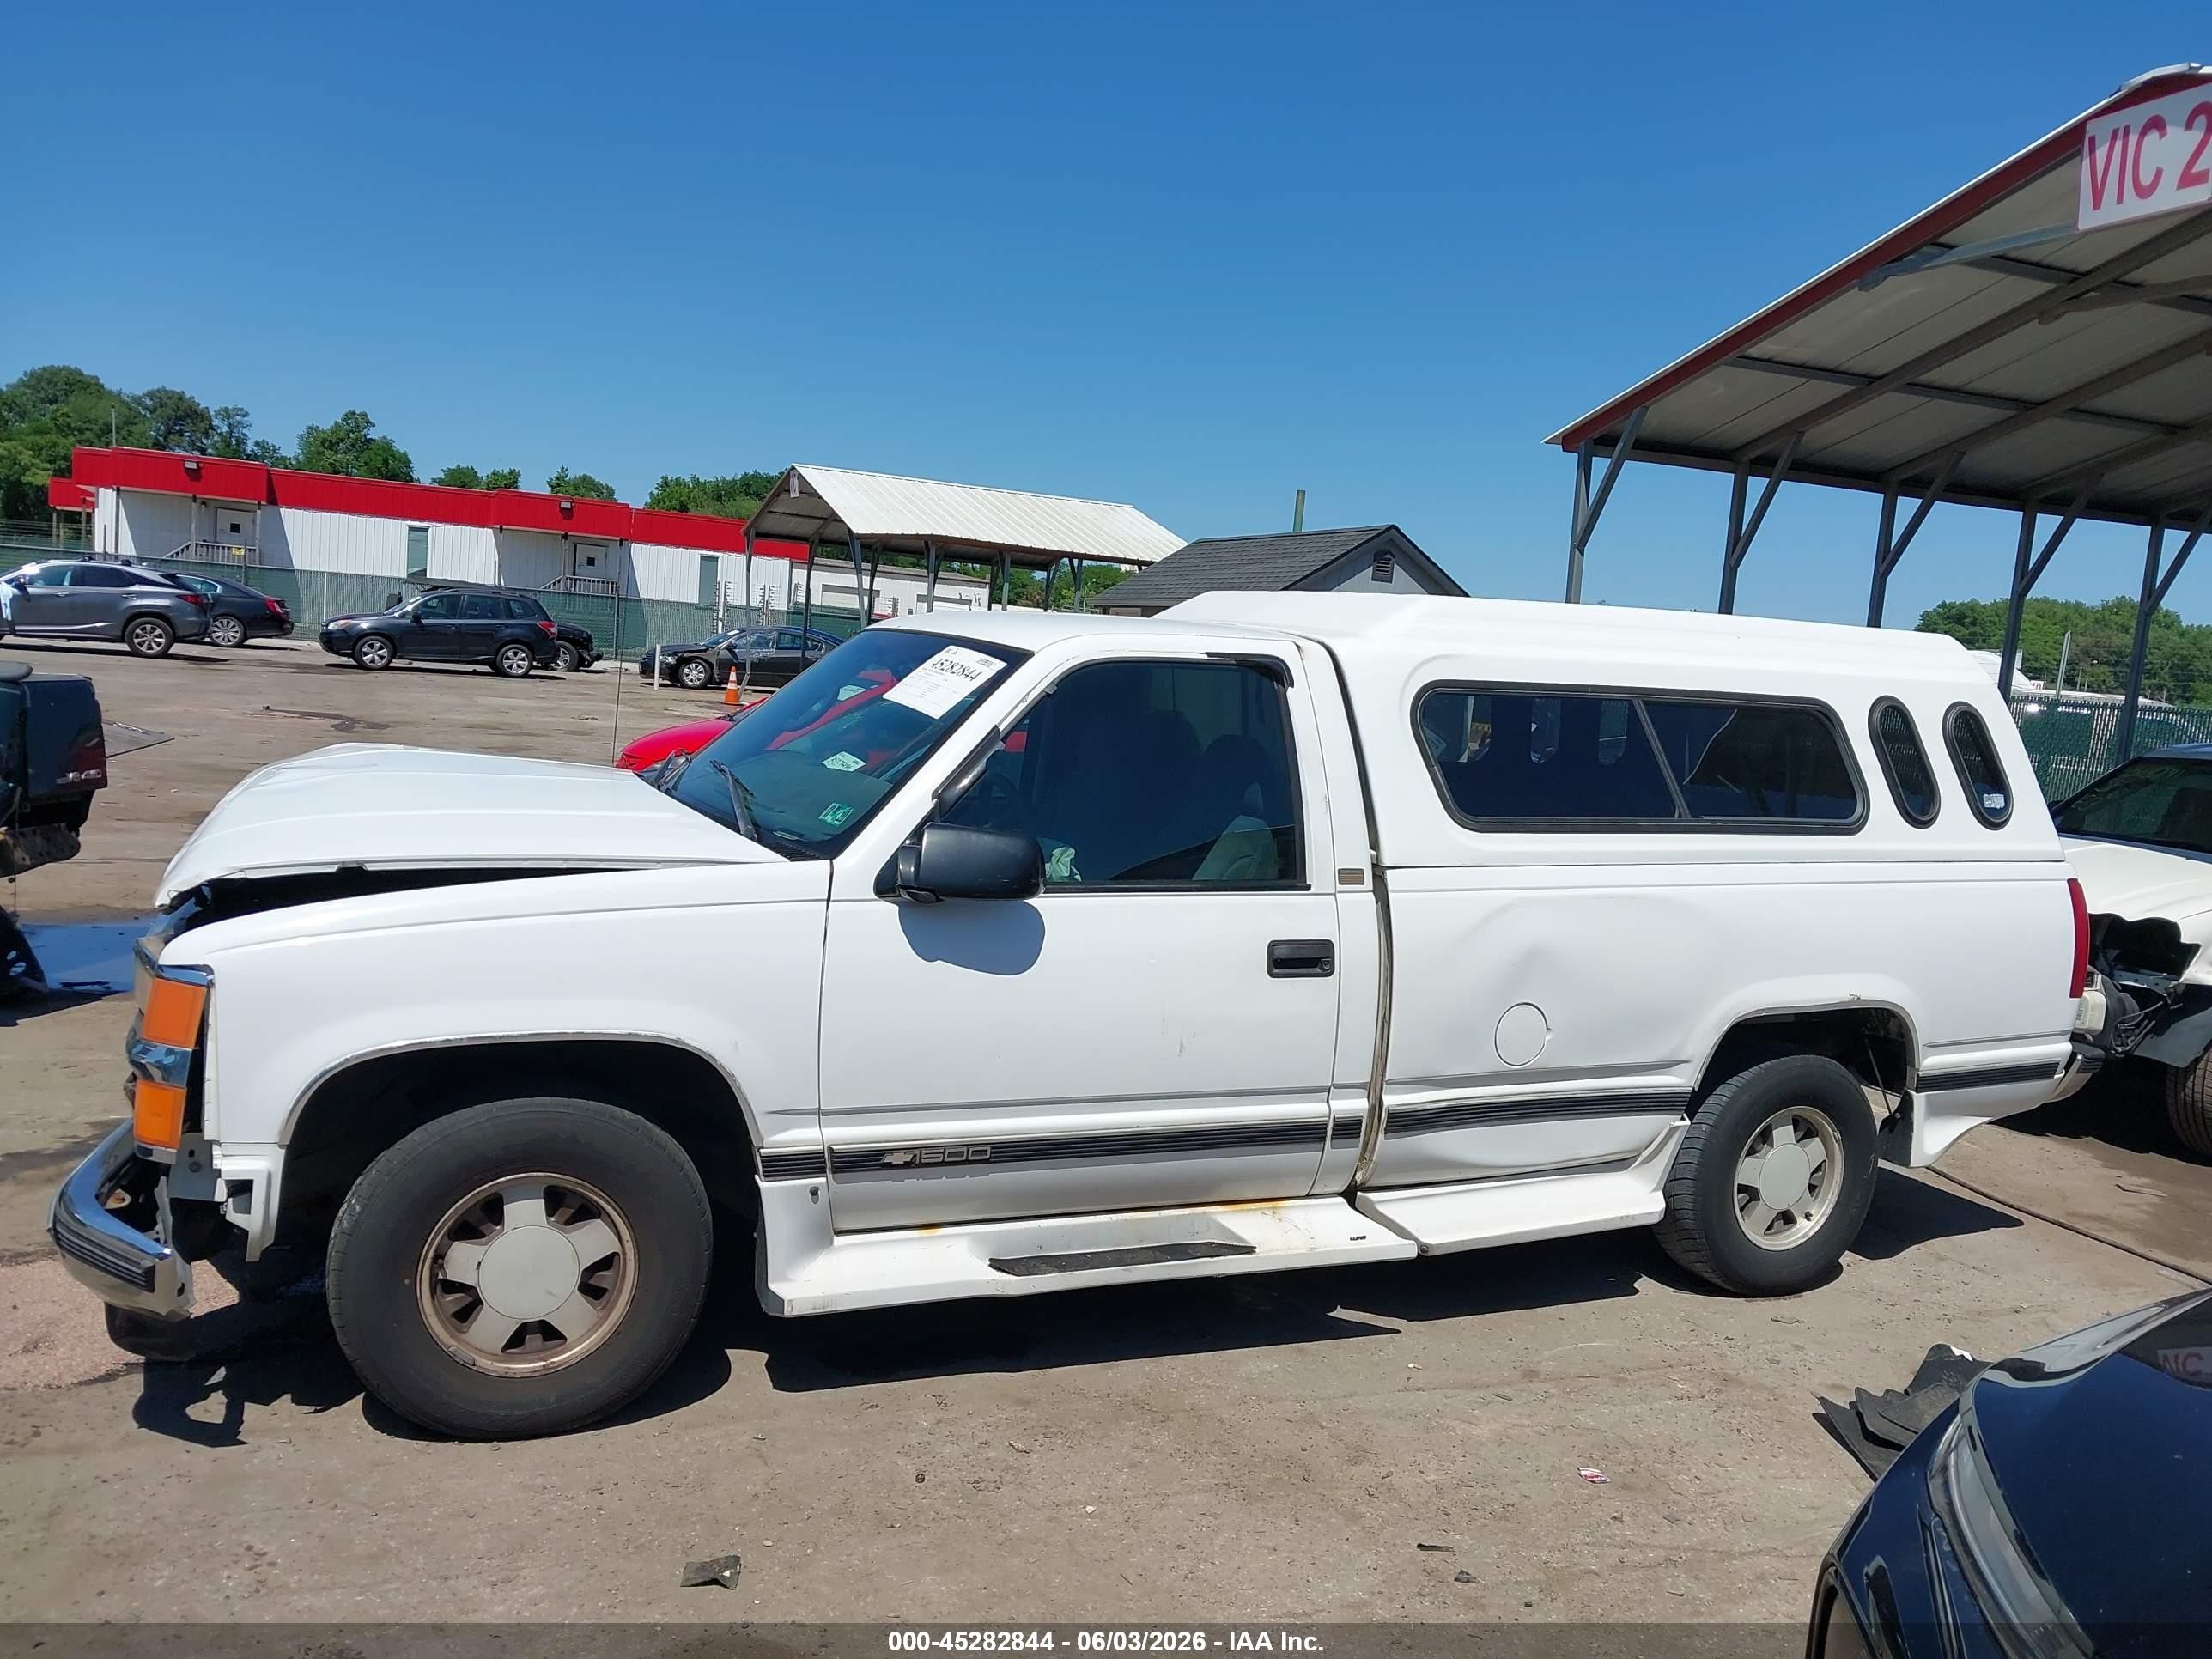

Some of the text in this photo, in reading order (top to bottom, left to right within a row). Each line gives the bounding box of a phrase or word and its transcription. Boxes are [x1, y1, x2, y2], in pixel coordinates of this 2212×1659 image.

[2088, 100, 2212, 210] VIC 2
[931, 659, 982, 681] 45282844
[911, 1146, 991, 1164] 1500
